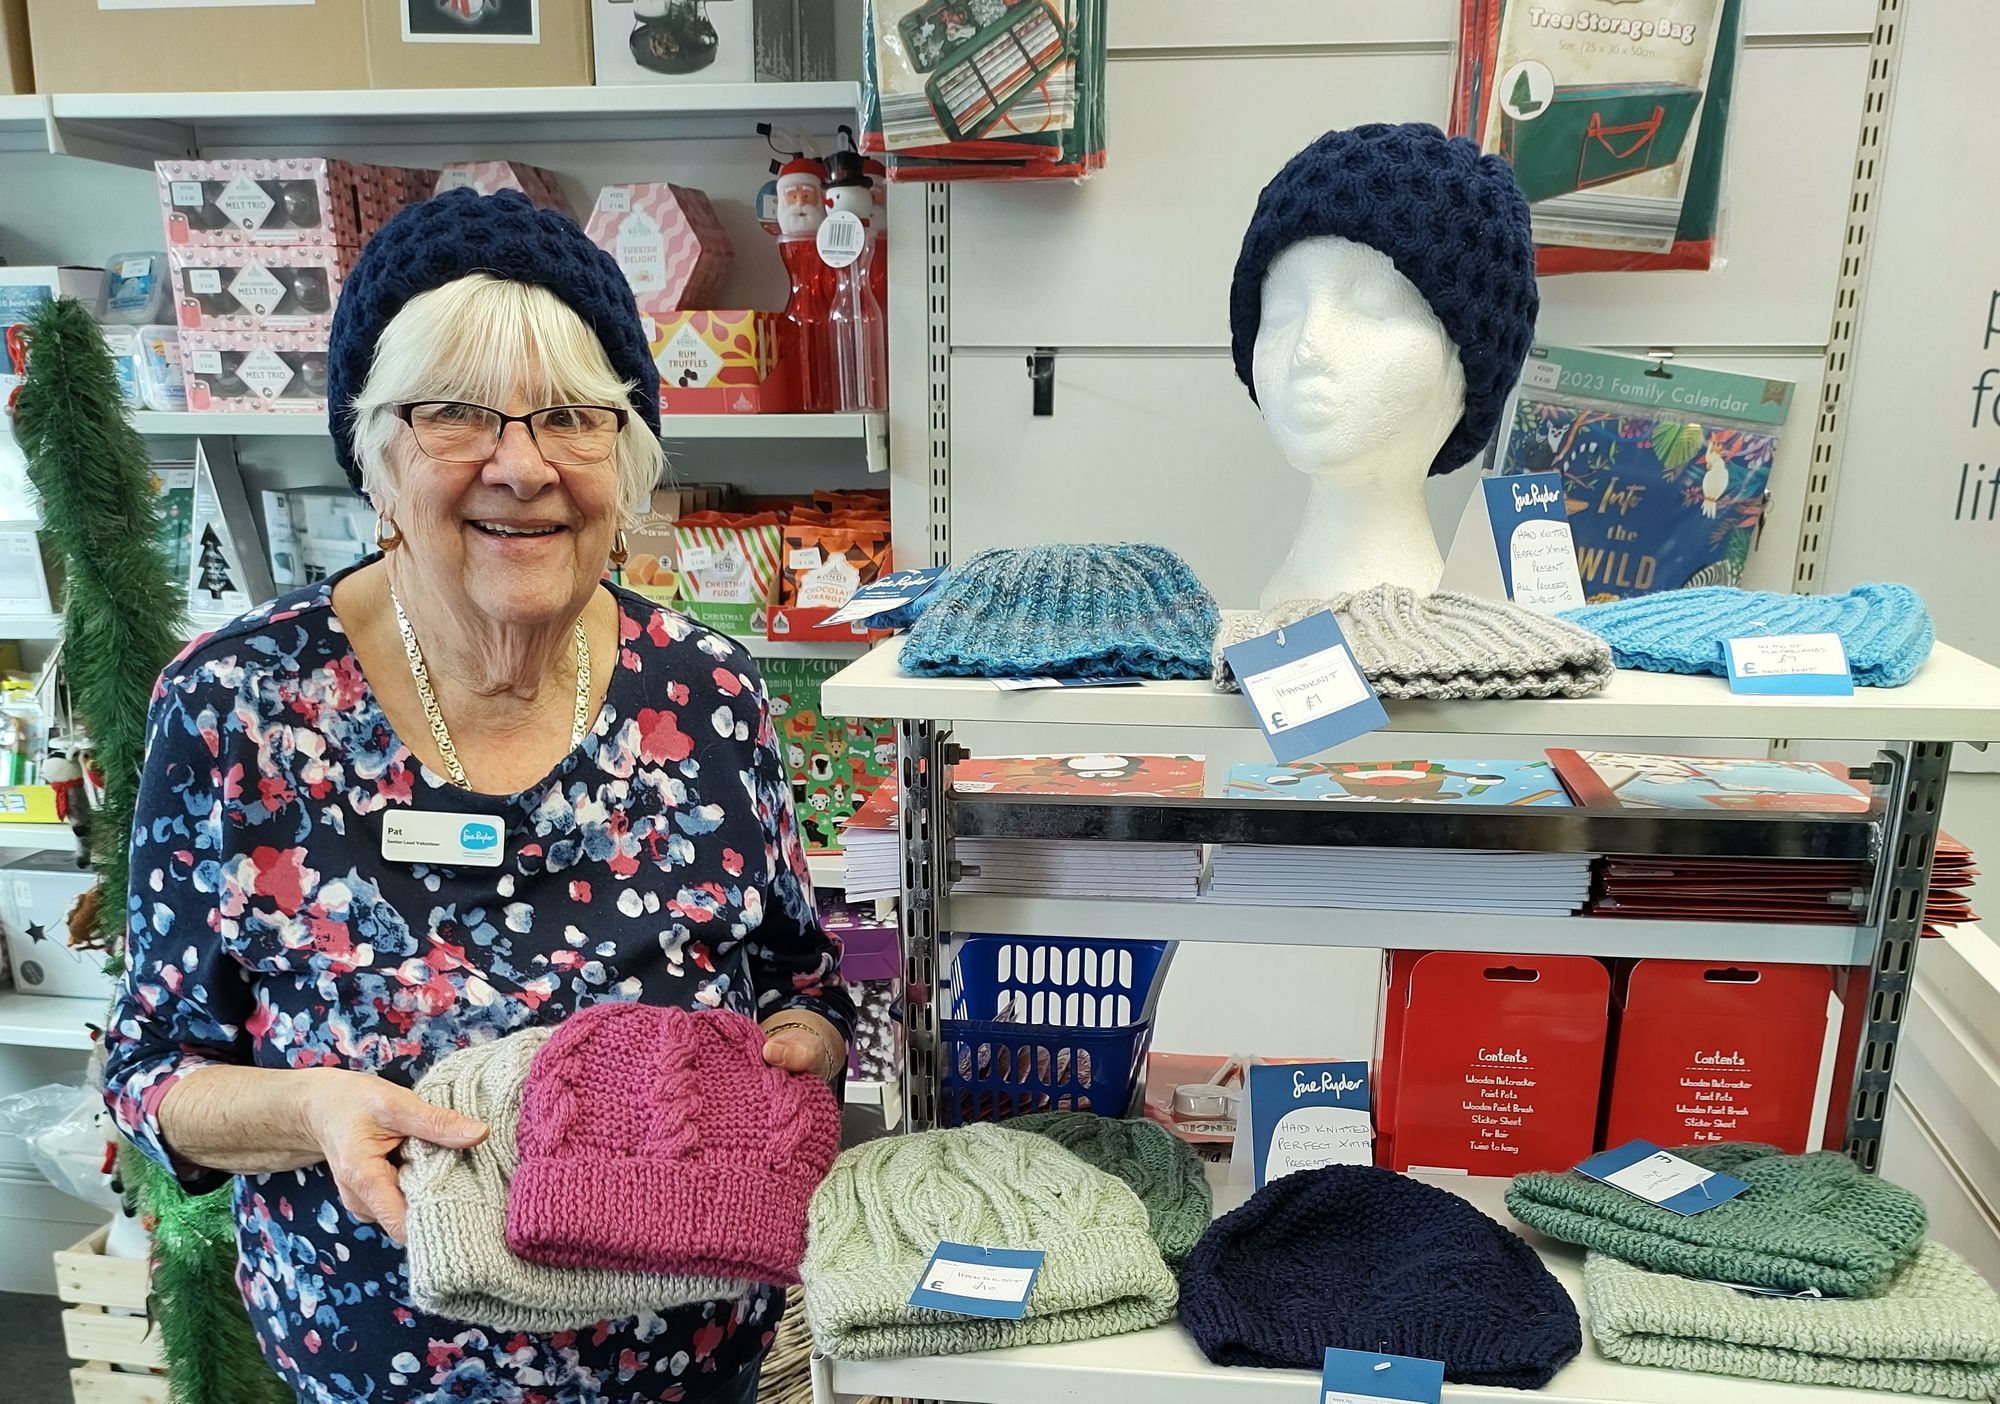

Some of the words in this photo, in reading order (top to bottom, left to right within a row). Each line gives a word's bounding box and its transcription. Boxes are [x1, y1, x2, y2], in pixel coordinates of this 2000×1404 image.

[1529, 7, 1574, 30] Tree
[1576, 10, 1655, 41] Storage
[1657, 18, 1697, 46] Bag
[225, 201, 244, 209] MELT
[247, 201, 267, 209] TRIO
[623, 246, 658, 254] TURKISH
[624, 255, 657, 264] DELIGHT
[238, 287, 257, 295] MELT
[260, 287, 279, 295] TRIO
[678, 350, 697, 358] RUM
[668, 360, 708, 368] TRUFFLES
[246, 371, 265, 379] MELT
[268, 371, 287, 379] TRIO
[1560, 369, 1605, 391] 2023
[1611, 377, 1667, 406] Family
[1671, 387, 1750, 413] Calendar
[1512, 483, 1532, 512] Sue
[1531, 483, 1560, 512] Ryder
[1577, 546, 1657, 590] WILD
[702, 613, 744, 622] CHRISTMAS
[712, 622, 736, 630] FUDGE
[1742, 662, 1758, 674] £
[795, 674, 804, 687] to
[1270, 711, 1288, 729] £
[388, 827, 402, 835] Pat
[463, 829, 477, 842] Sue
[477, 831, 495, 845] Ryder
[1478, 1048, 1528, 1063] Contents
[1694, 1050, 1745, 1066] Contents
[1293, 1070, 1321, 1098] Sue
[1321, 1072, 1364, 1100] Ryder
[1465, 1074, 1495, 1085] Wooden
[1496, 1076, 1537, 1087] Nutcracker
[1680, 1077, 1710, 1087] Wooden
[1711, 1078, 1752, 1089] Nutcracker
[1481, 1088, 1499, 1098] Paint
[1500, 1089, 1518, 1099] Pots
[1695, 1091, 1714, 1101] Paint
[1715, 1092, 1733, 1101] Pots
[1462, 1101, 1492, 1111] Wooden
[1493, 1102, 1512, 1112] Paint
[1512, 1103, 1534, 1113] Brush
[1676, 1104, 1706, 1114] Wooden
[1707, 1105, 1726, 1115] Paint
[1727, 1106, 1749, 1115] Brush
[1471, 1114, 1499, 1125] Sticker
[1500, 1116, 1522, 1126] Sheet
[1684, 1117, 1713, 1127] Sticker
[1713, 1119, 1737, 1128] Sheet
[1183, 1123, 1236, 1133] ENCIL
[1315, 1124, 1370, 1134] KNITTED
[1277, 1137, 1331, 1151] PERFECT
[1470, 1140, 1489, 1150] Twine
[1491, 1141, 1500, 1151] to
[1501, 1143, 1519, 1154] hang
[1285, 1155, 1333, 1168] PRESENTS
[930, 1280, 945, 1290] £
